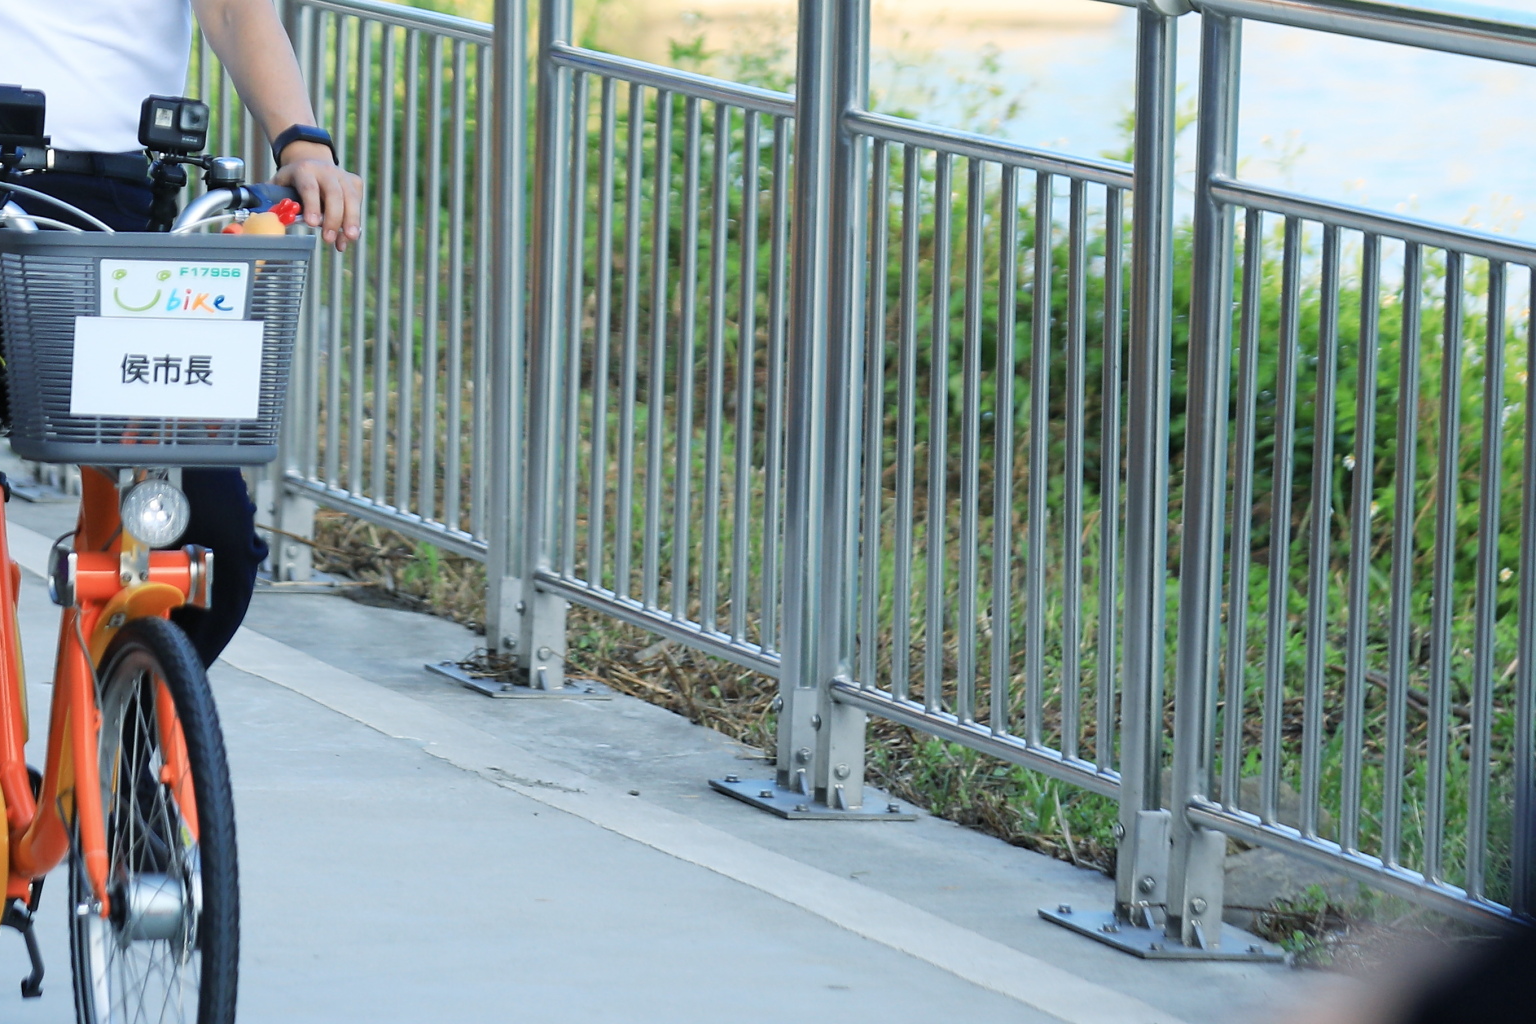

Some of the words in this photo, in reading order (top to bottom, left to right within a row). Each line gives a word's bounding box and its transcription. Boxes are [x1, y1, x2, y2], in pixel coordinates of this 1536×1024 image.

[179, 267, 241, 278] F17956
[121, 353, 213, 386] 侯市長
